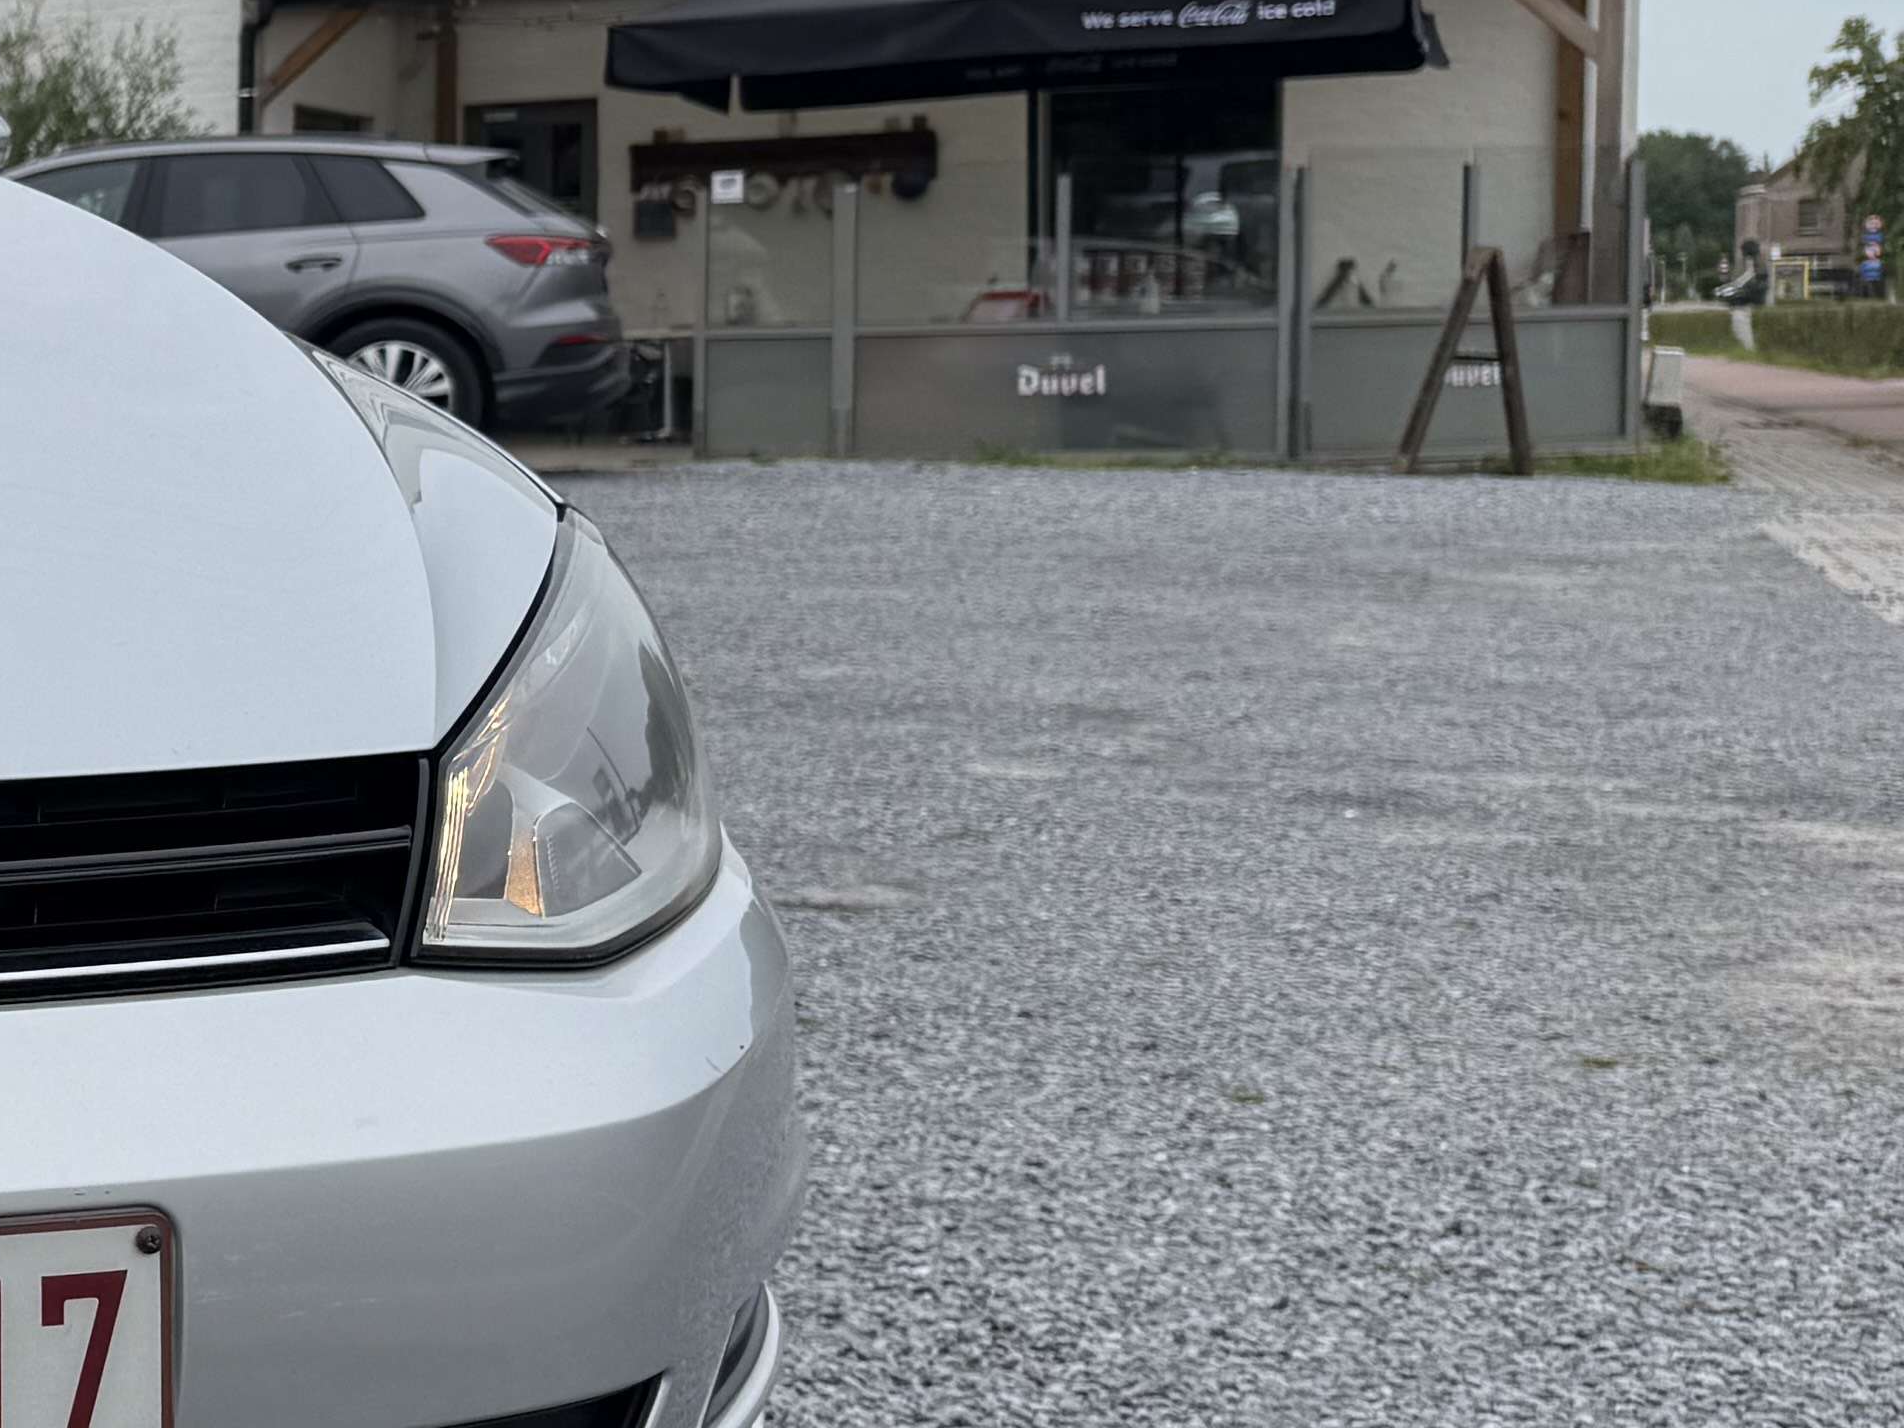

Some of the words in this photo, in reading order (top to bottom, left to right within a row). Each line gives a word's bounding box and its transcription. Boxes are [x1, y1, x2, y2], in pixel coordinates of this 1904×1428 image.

[1081, 11, 1114, 29] We
[1118, 10, 1174, 28] serve
[1256, 1, 1287, 21] ice
[1017, 363, 1106, 396] Duvel
[1444, 361, 1502, 388] uvel
